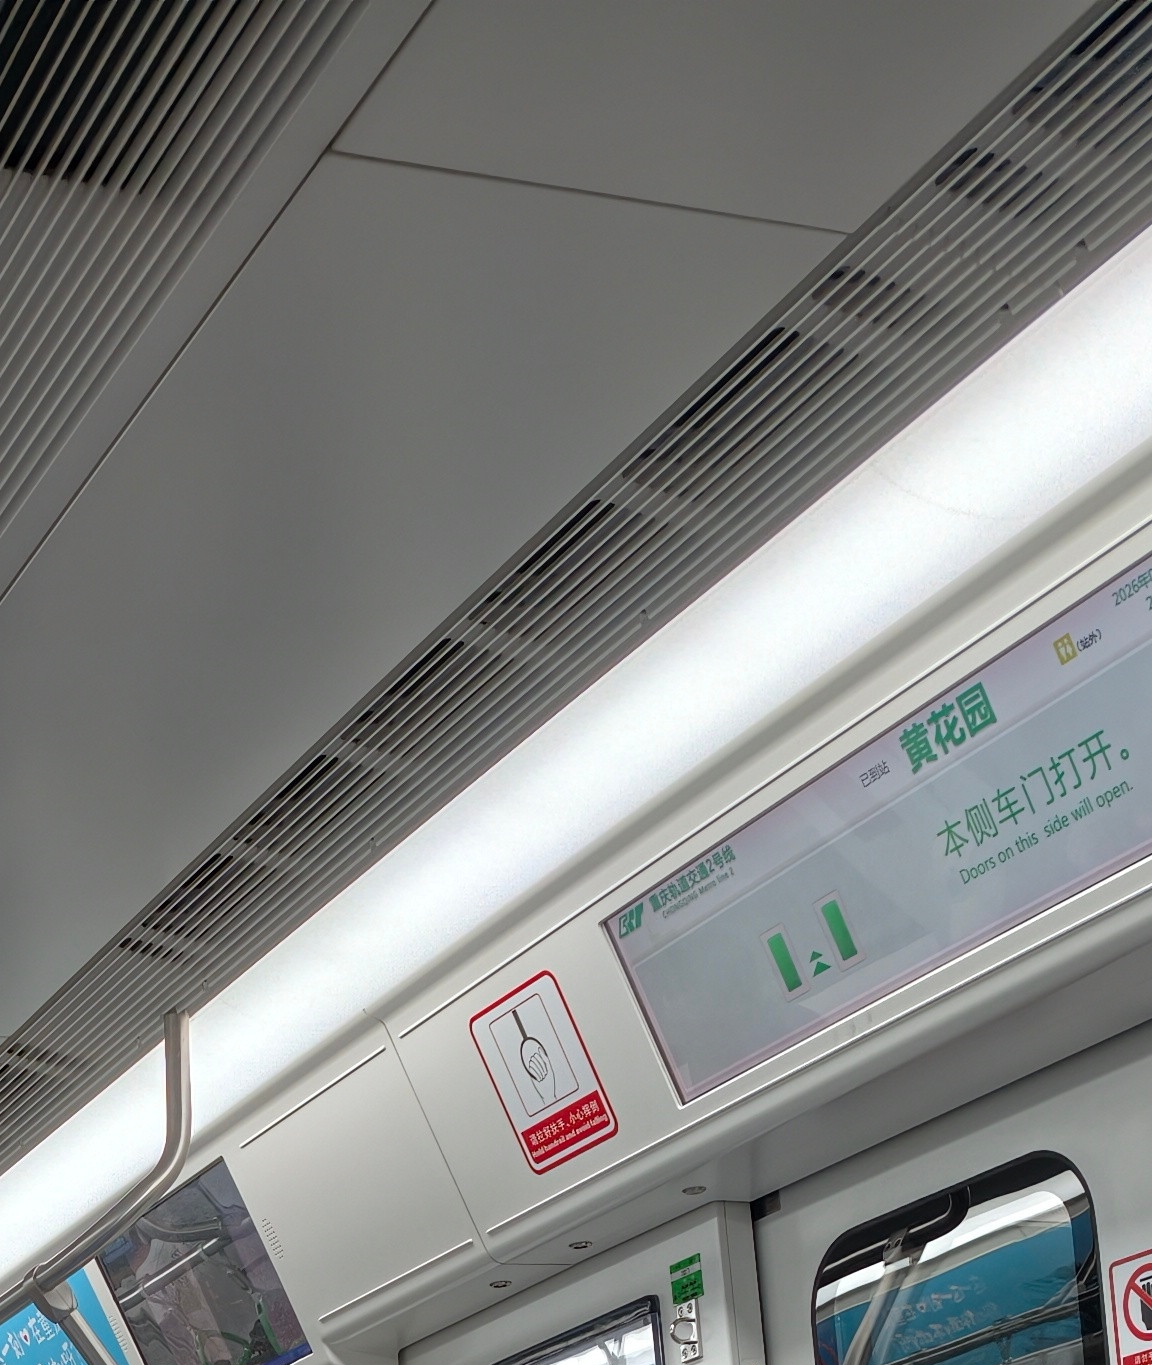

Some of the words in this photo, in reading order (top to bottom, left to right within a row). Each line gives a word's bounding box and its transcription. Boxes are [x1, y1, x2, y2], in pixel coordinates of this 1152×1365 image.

[859, 760, 890, 788] 已到站
[899, 682, 997, 775] 黄花园
[937, 730, 1130, 857] 本侧车门打开。
[959, 855, 997, 885] Doors
[998, 846, 1015, 864] on
[1015, 831, 1039, 853] this
[1043, 814, 1070, 838] side
[1071, 796, 1094, 822] will
[1095, 780, 1134, 807] open.
